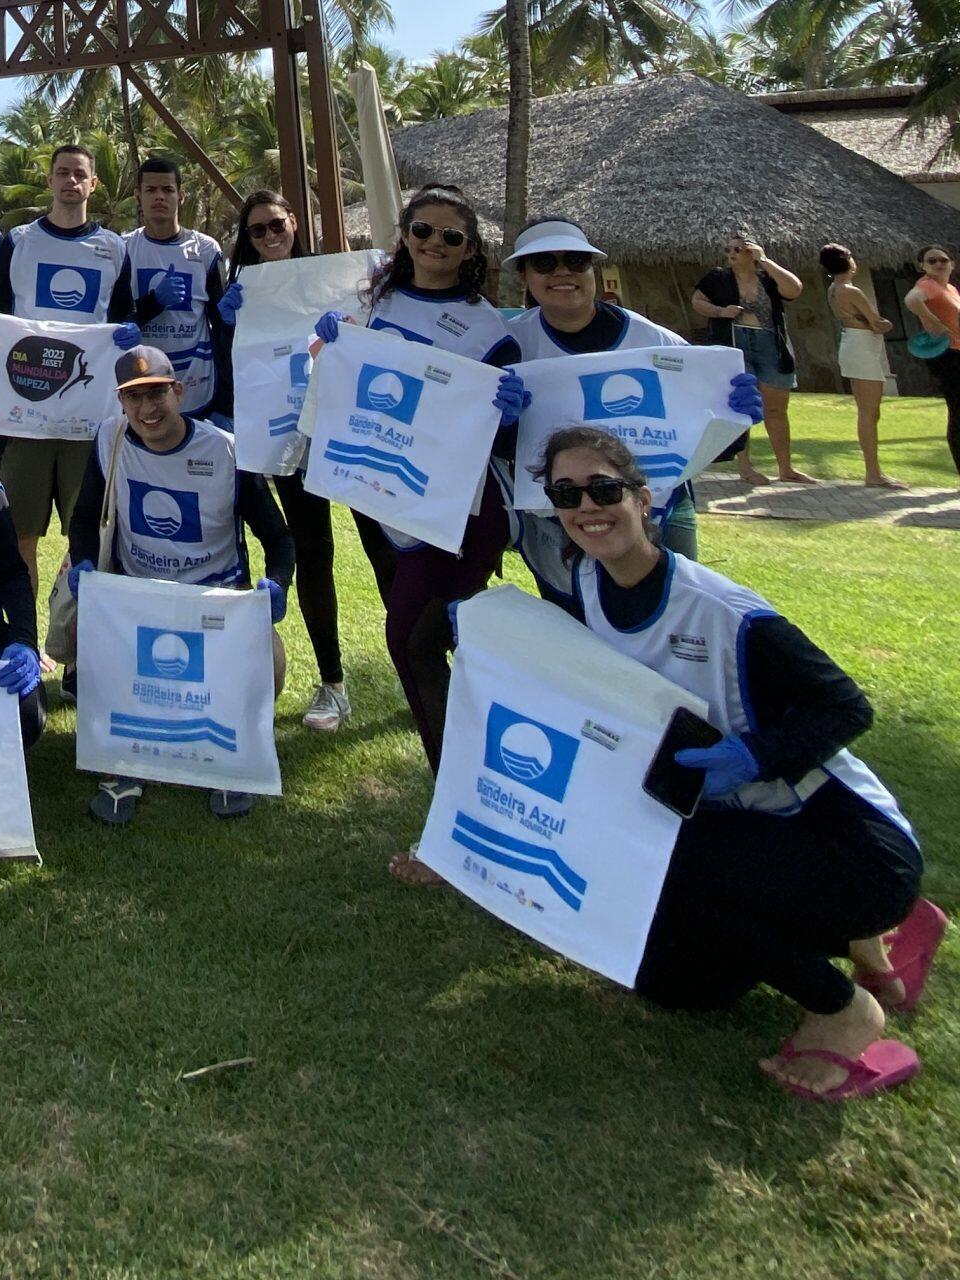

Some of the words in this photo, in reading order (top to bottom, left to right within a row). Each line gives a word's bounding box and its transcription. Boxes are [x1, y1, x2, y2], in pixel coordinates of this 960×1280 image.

[12, 351, 28, 362] DIA
[42, 348, 65, 360] 2023
[12, 373, 51, 391] LIMPEZA
[386, 427, 414, 448] Azul
[608, 424, 637, 438] eira
[643, 426, 677, 441] Azul
[130, 543, 180, 568] Bandeira
[184, 552, 212, 568] Azul
[185, 691, 211, 705] Azul
[477, 776, 526, 815] Bandeira
[529, 805, 567, 835] Azul
